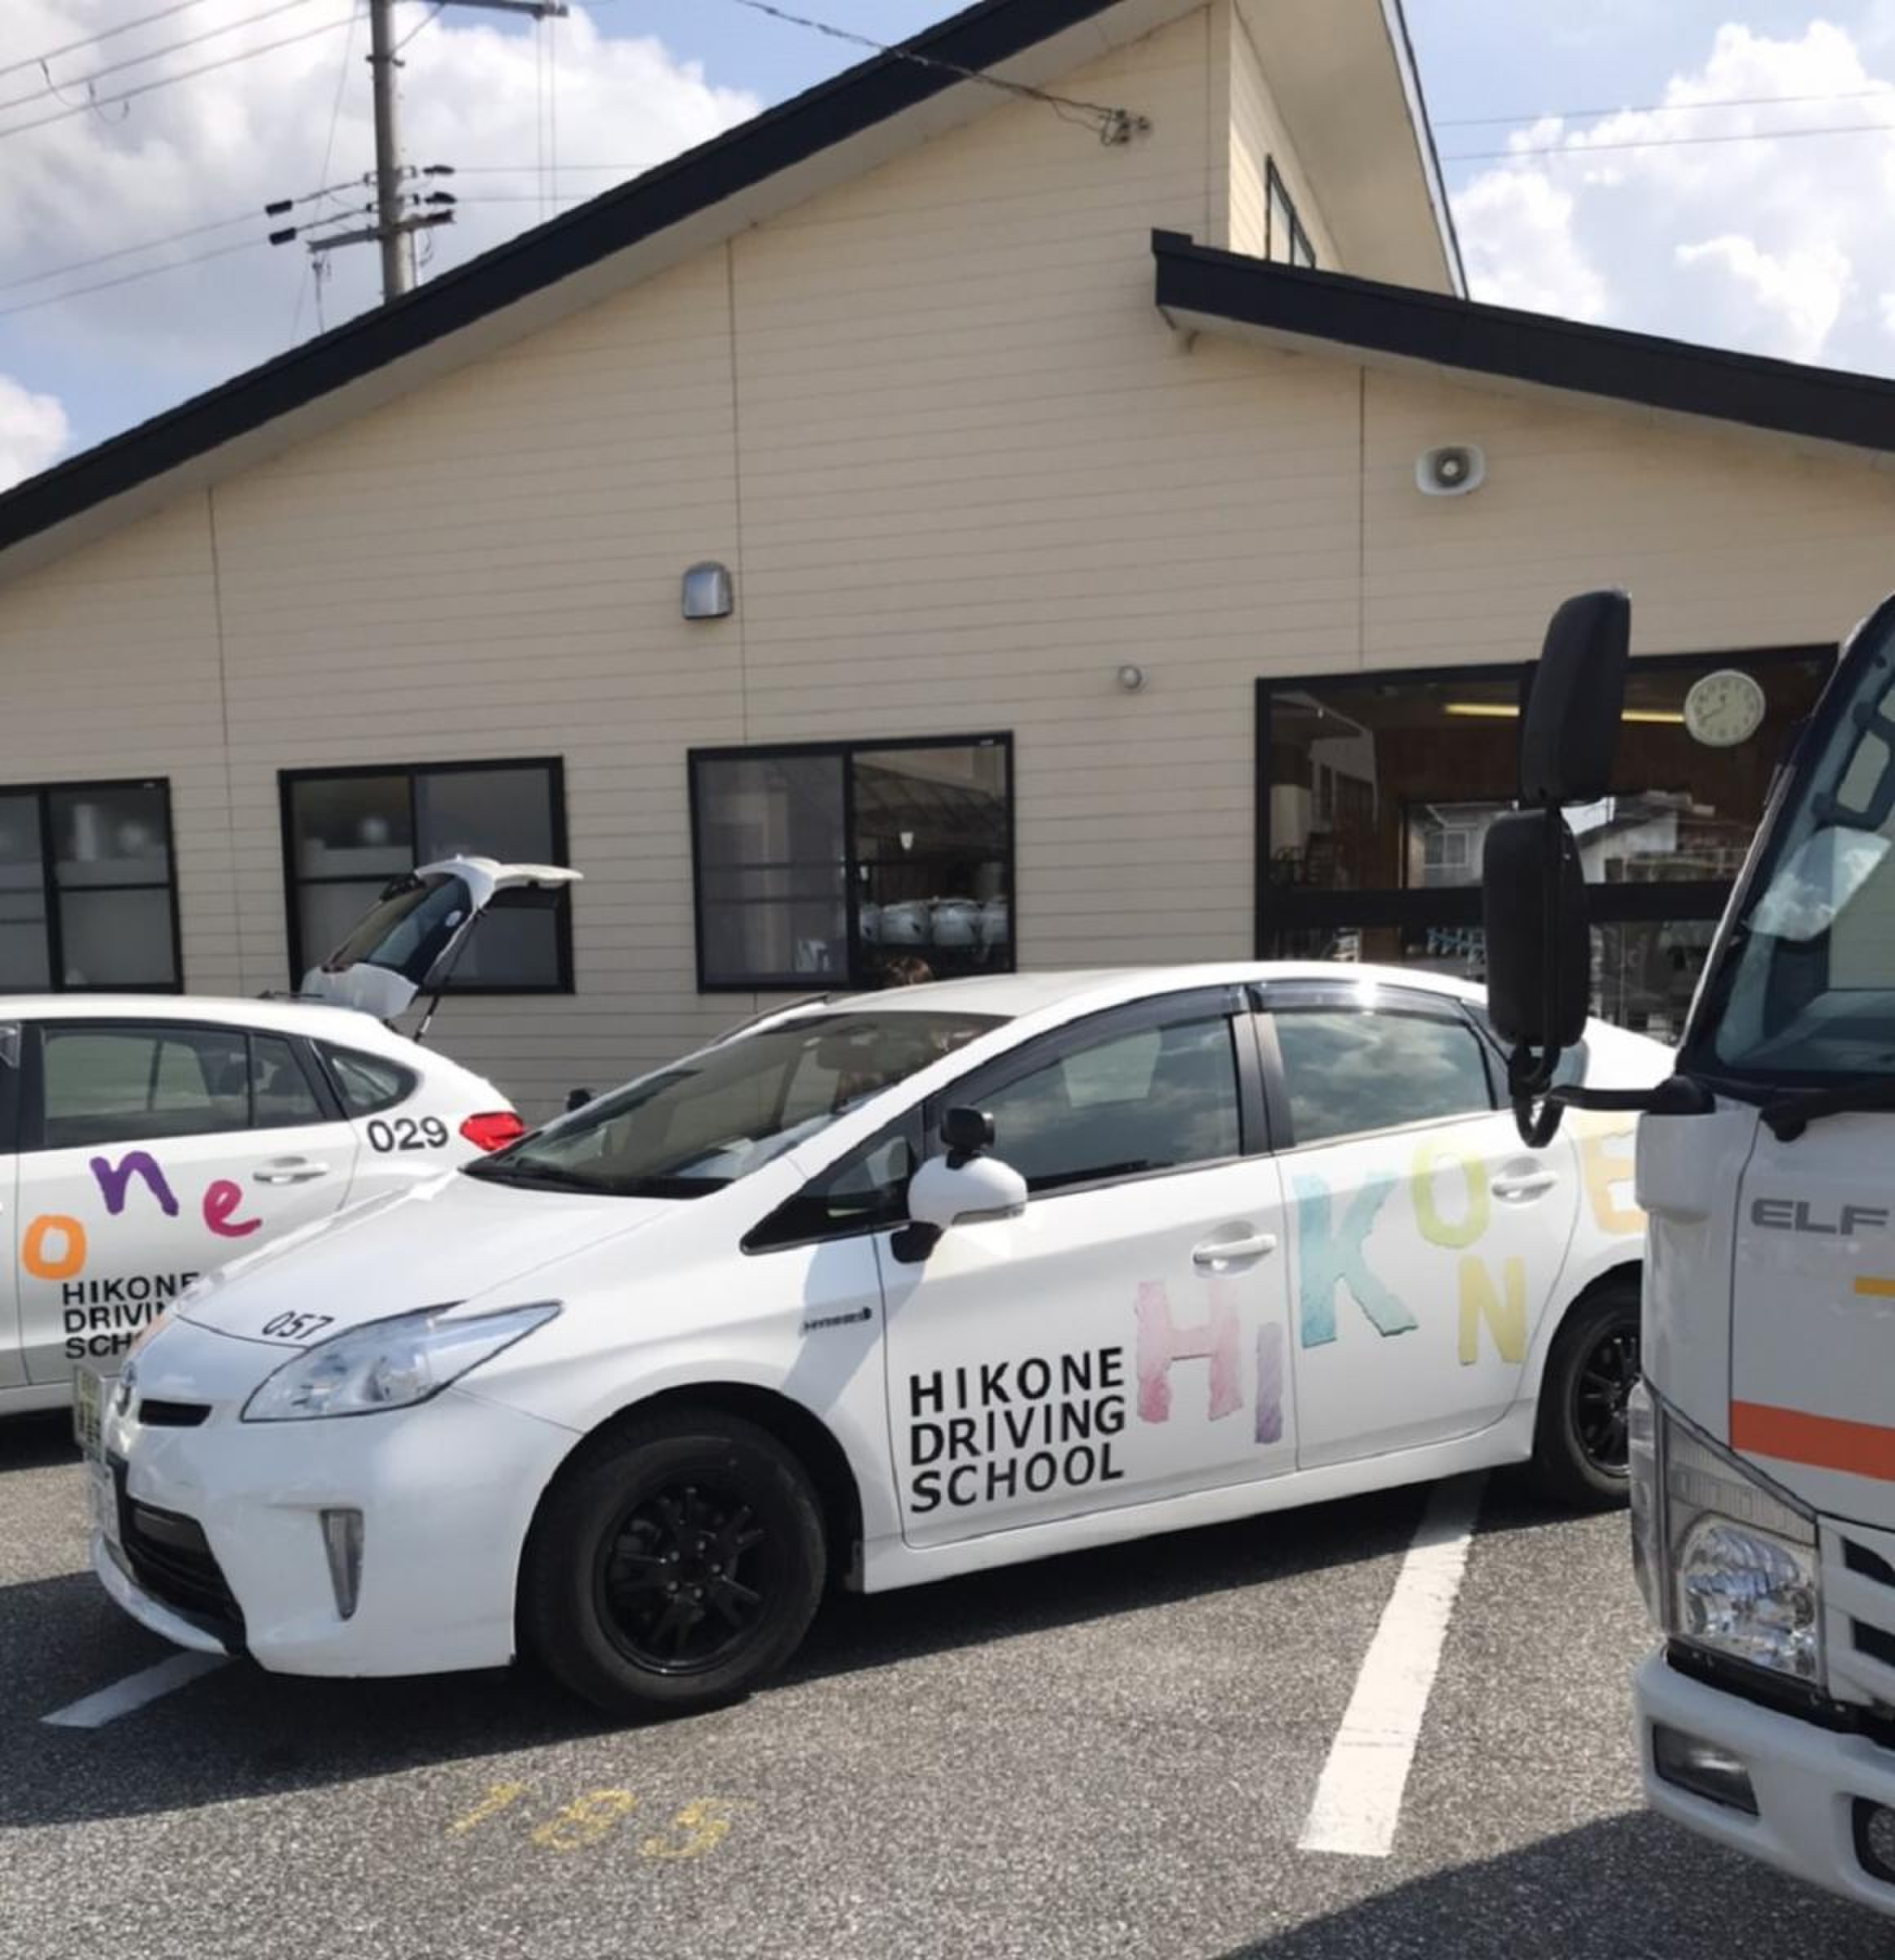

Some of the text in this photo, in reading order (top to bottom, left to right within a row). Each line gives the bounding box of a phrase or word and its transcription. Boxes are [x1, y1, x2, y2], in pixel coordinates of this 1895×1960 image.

[367, 1116, 448, 1153] 029
[1750, 1197, 1890, 1236] ELF
[65, 1302, 167, 1333] DRIVI
[261, 1310, 335, 1339] 057
[65, 1332, 141, 1360] SCH
[909, 1347, 1124, 1417] HIKONE
[911, 1394, 1126, 1467] DRIVING
[911, 1442, 1124, 1513] SCHOOL
